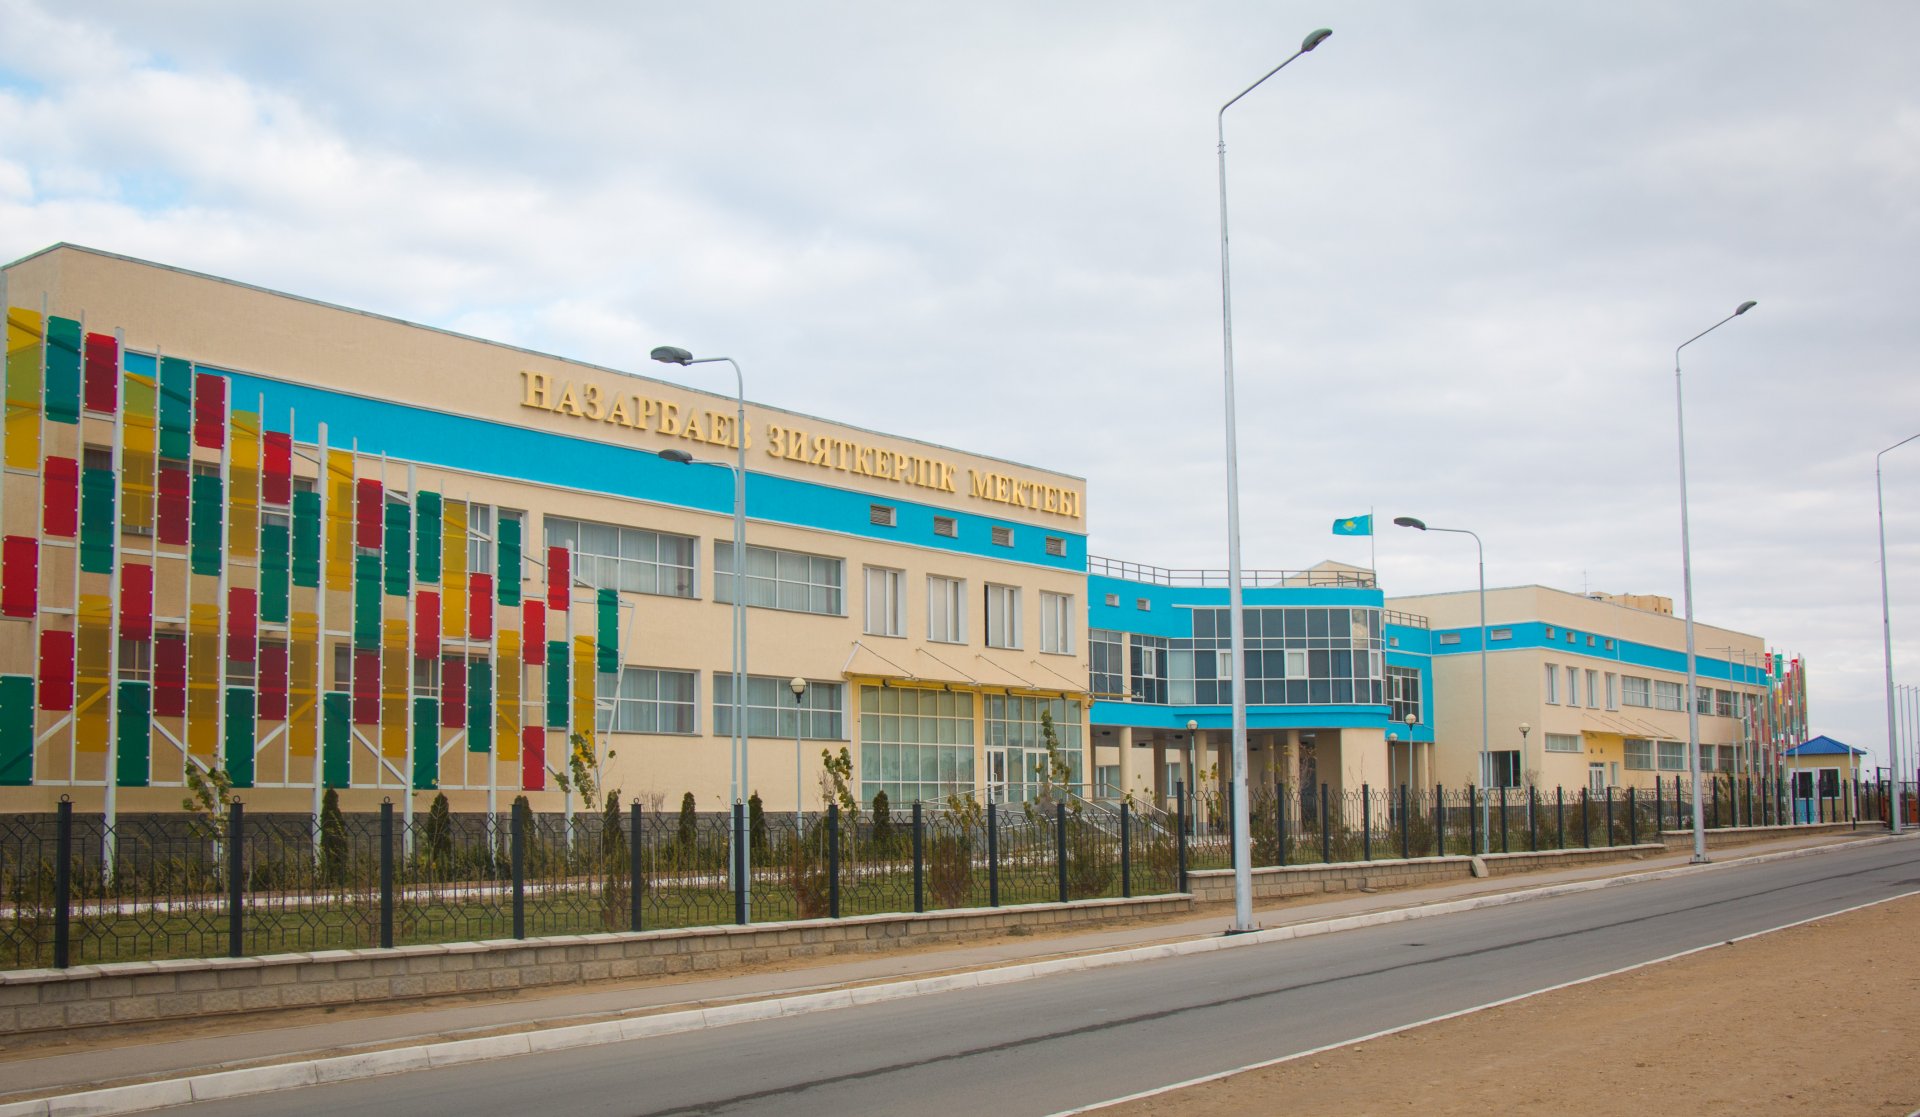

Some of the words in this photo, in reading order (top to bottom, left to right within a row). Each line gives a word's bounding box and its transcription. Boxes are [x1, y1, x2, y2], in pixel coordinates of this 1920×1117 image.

[520, 370, 752, 450] НАЗАРБАЕВ
[766, 423, 957, 493] ЗИЯТКЕРЛІК
[968, 469, 1081, 518] МЕКТЕБІ
